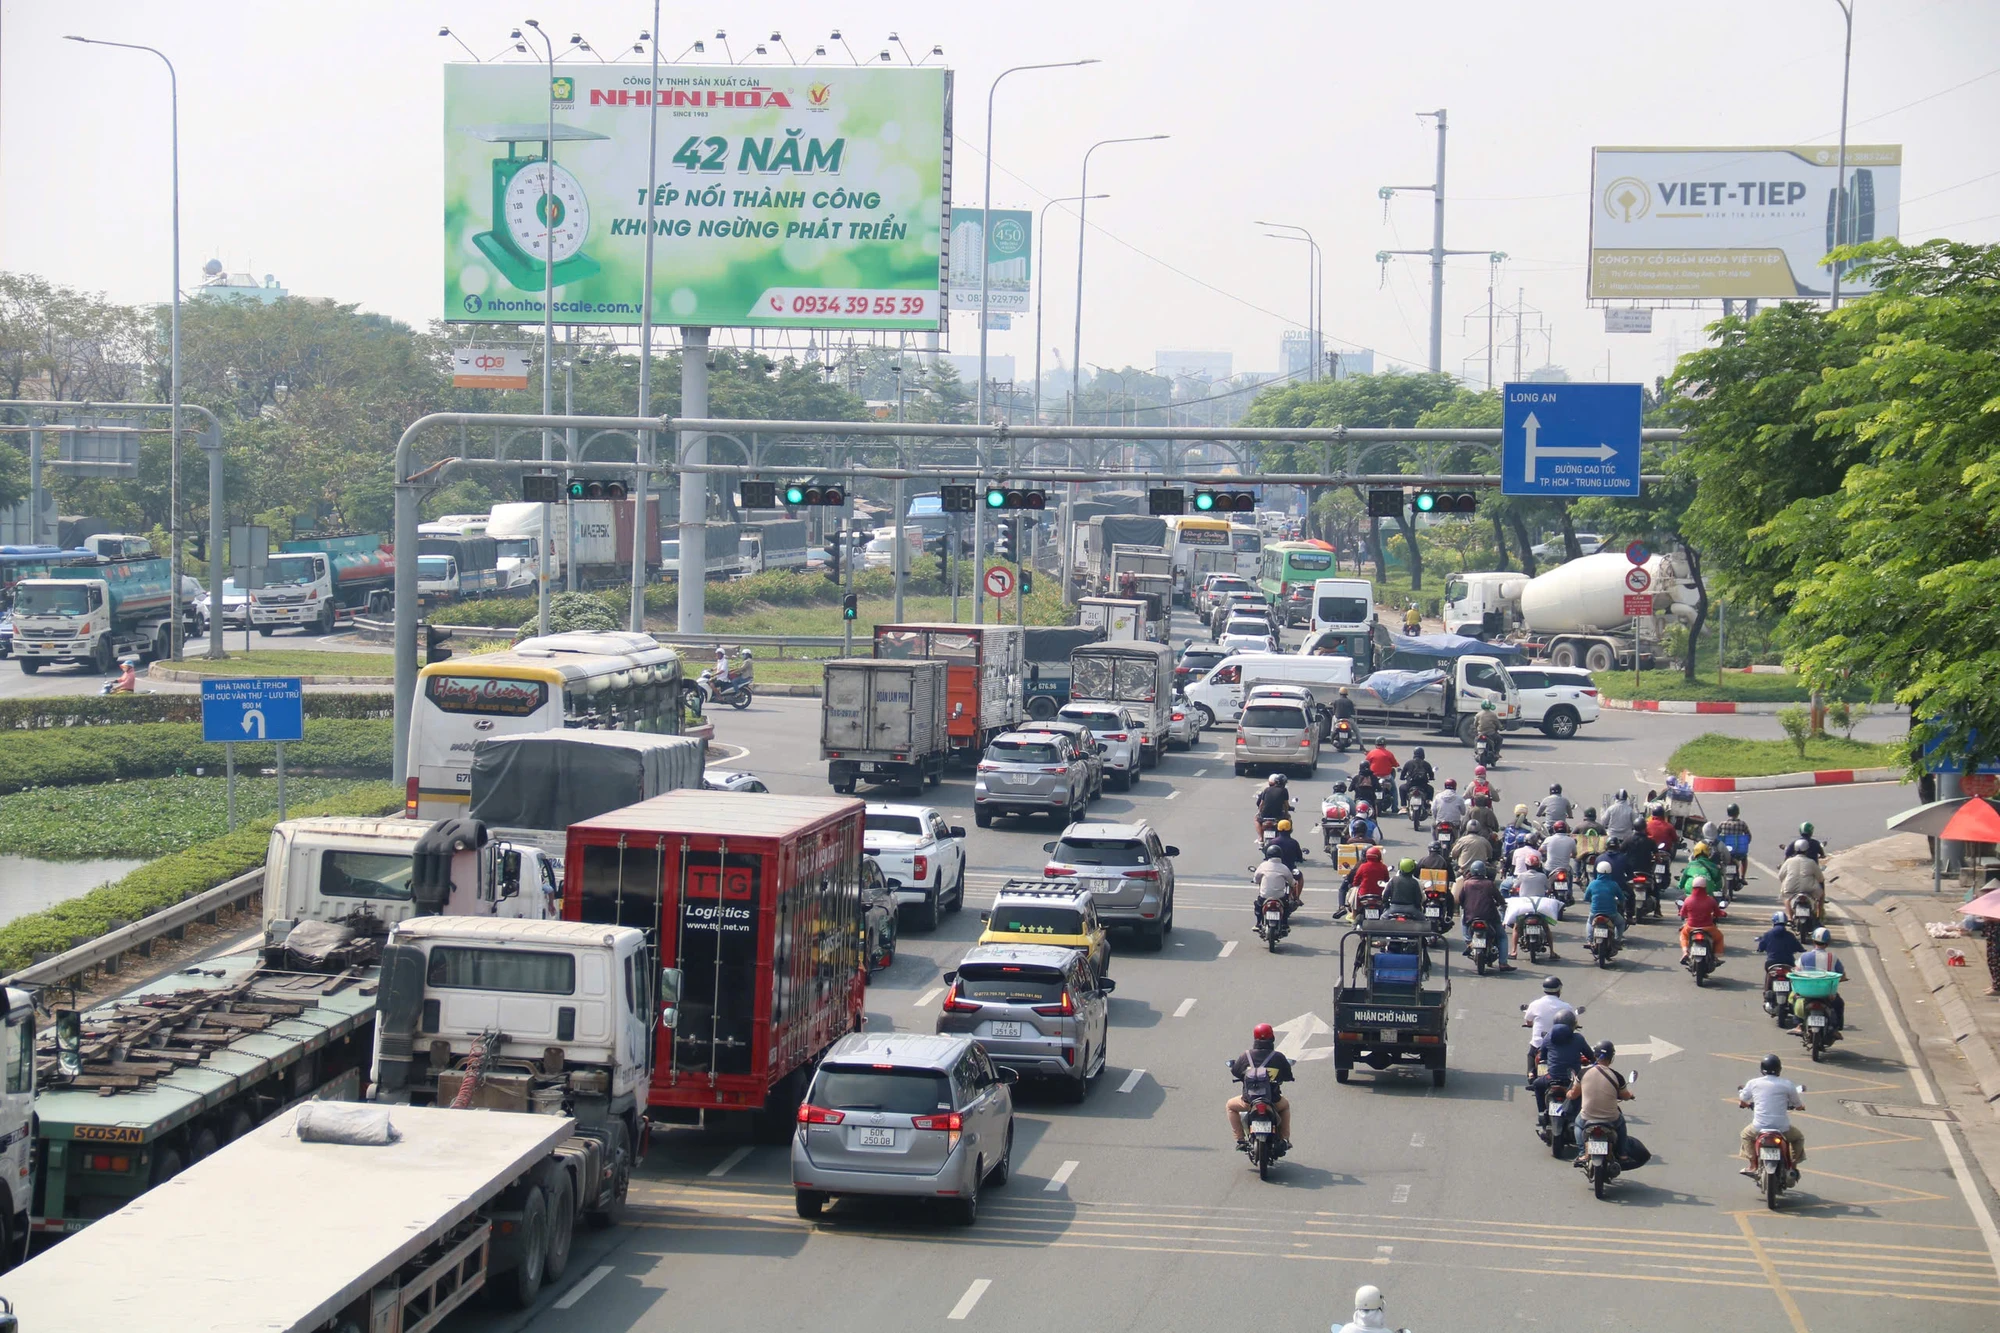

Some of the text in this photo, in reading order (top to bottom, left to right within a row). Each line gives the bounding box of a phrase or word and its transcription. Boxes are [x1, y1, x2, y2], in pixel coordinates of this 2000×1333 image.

[622, 76, 651, 86] CÔNG
[666, 77, 690, 86] TNHH
[692, 75, 711, 86] SẢN
[713, 76, 738, 87] XUẤT
[739, 78, 760, 87] CÂN
[590, 87, 701, 107] NHƠN
[672, 127, 847, 175] 42 NĂM
[637, 181, 881, 210] TẾP NỐI THÀNH CÔNG
[1657, 181, 1807, 206] VIET-TIEP
[697, 215, 780, 239] NGỪNG
[785, 216, 843, 239] PHÁT
[849, 213, 908, 240] TRIỂN
[995, 229, 1022, 242] 450
[1598, 253, 1629, 265] CÔNG
[1631, 255, 1646, 265] TY
[792, 295, 925, 315] 0934 39 55 39
[1510, 392, 1557, 403] LONG AN
[1555, 462, 1617, 475] ĐƯỜNG CAO TỐC
[1540, 477, 1551, 487] TP.
[1552, 478, 1569, 487] HCM
[1576, 478, 1602, 488] TRUNG
[215, 682, 231, 690] NHÀ
[232, 682, 251, 690] TANG
[262, 681, 288, 689] TP.HCM
[433, 677, 480, 704] Hùng
[216, 693, 231, 702] CỤC
[693, 871, 748, 894] TTG
[685, 904, 751, 920] Logistics
[686, 921, 750, 932] www.ttg.net.vn
[1354, 1009, 1418, 1023] NHẬN CHỞ HÀNG
[75, 1126, 143, 1143] SOOSAN
[870, 1128, 885, 1137] 60K
